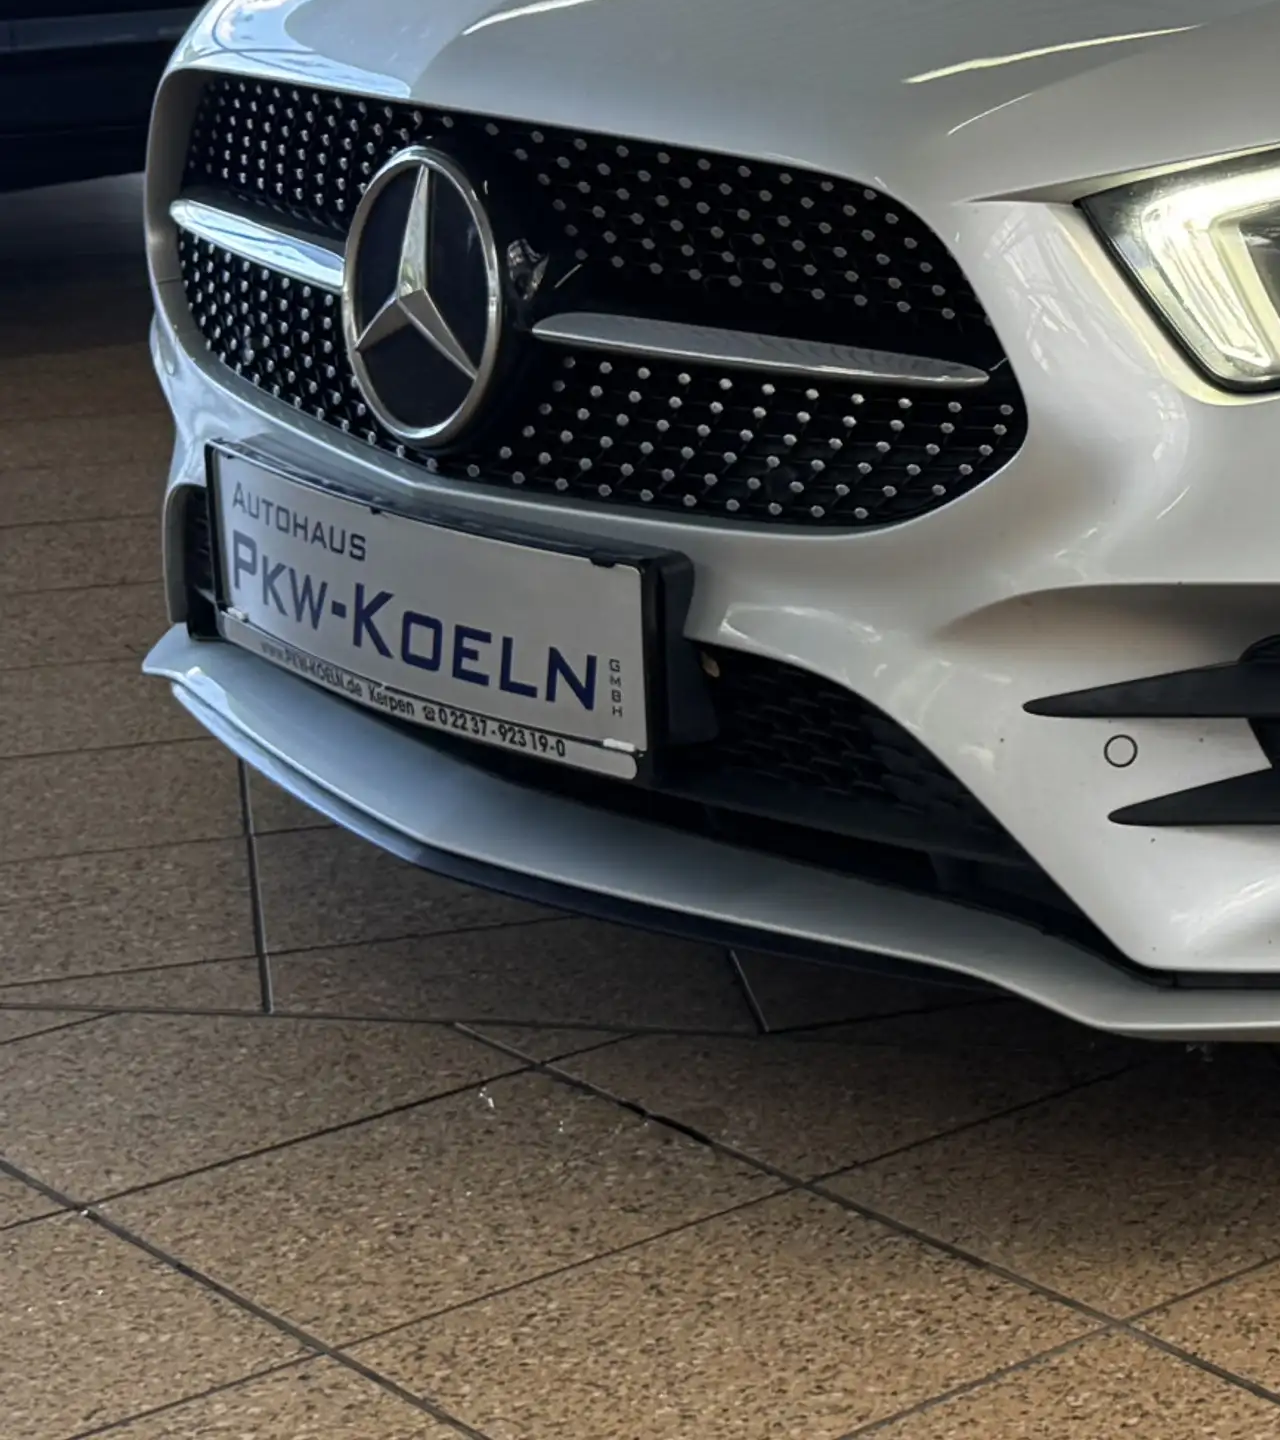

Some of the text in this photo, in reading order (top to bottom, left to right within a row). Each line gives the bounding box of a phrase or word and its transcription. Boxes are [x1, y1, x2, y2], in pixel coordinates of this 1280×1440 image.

[232, 481, 367, 562] AUTOHAUS
[232, 529, 598, 711] PKW-KOELN
[368, 684, 415, 717] Kerpen
